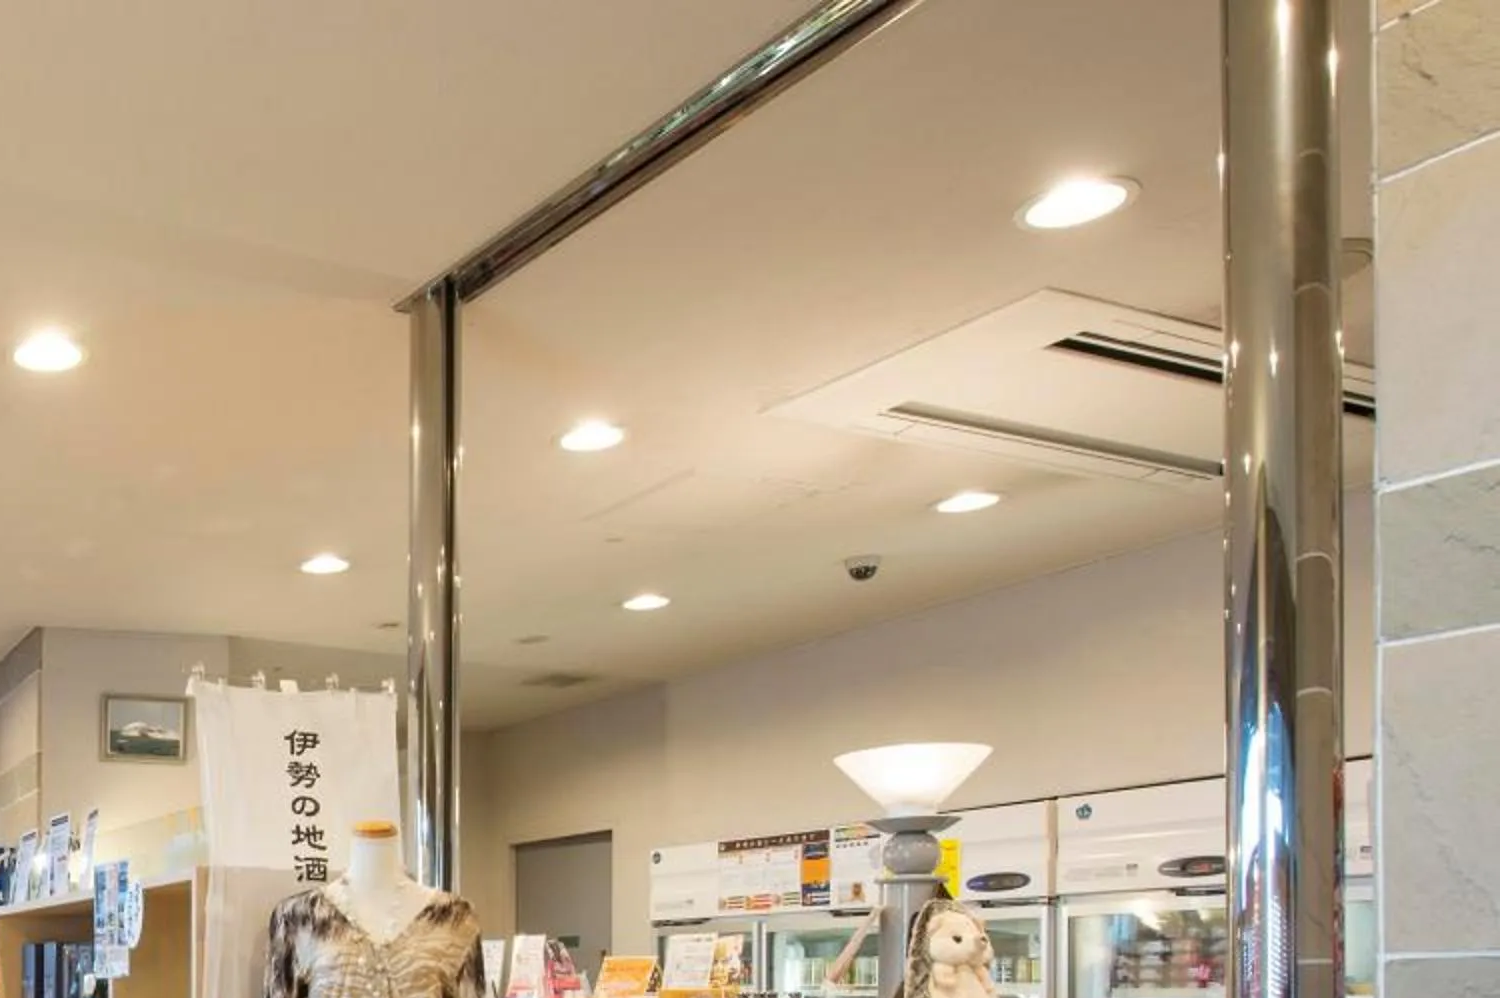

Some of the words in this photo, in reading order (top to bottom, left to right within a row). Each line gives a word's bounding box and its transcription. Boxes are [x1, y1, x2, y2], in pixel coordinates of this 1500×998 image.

[283, 729, 329, 883] 伊勢の地酒
